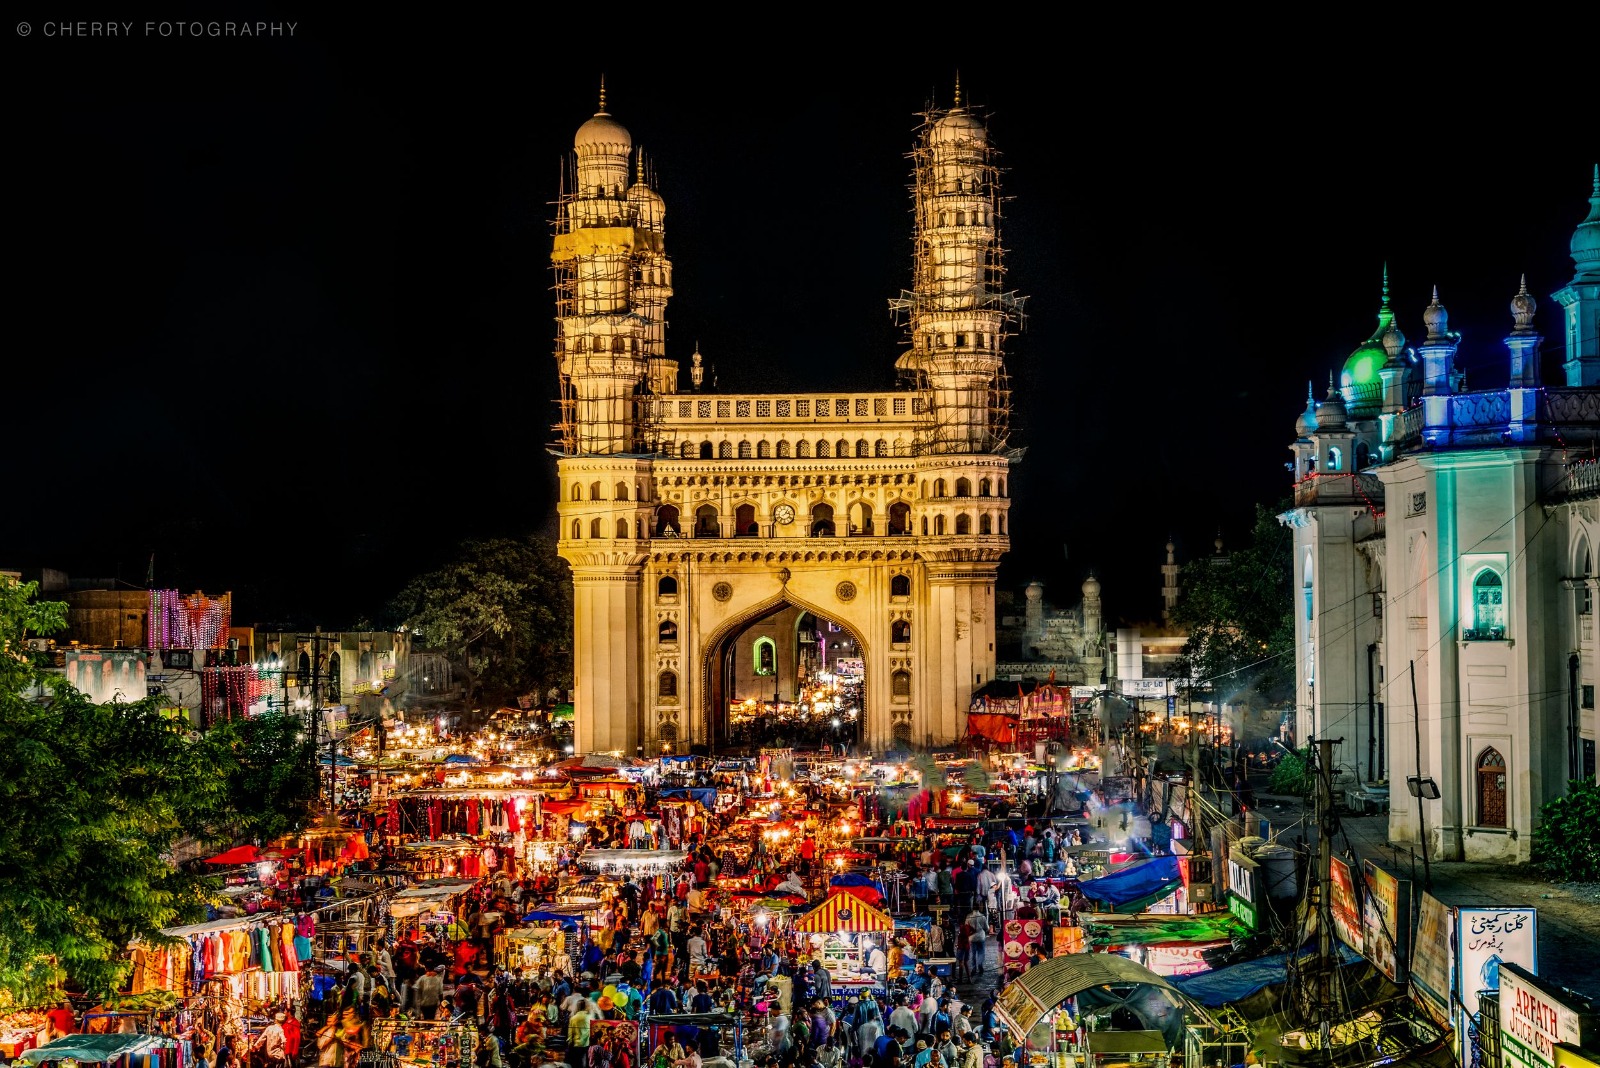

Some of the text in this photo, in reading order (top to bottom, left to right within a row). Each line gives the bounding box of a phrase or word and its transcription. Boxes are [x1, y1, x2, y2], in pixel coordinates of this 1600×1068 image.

[842, 988, 885, 996] PARISE
[1516, 987, 1558, 1039] ARFATH
[1510, 1007, 1532, 1046] JUICE
[1535, 1031, 1557, 1061] CENT
[1524, 1048, 1530, 1064] &
